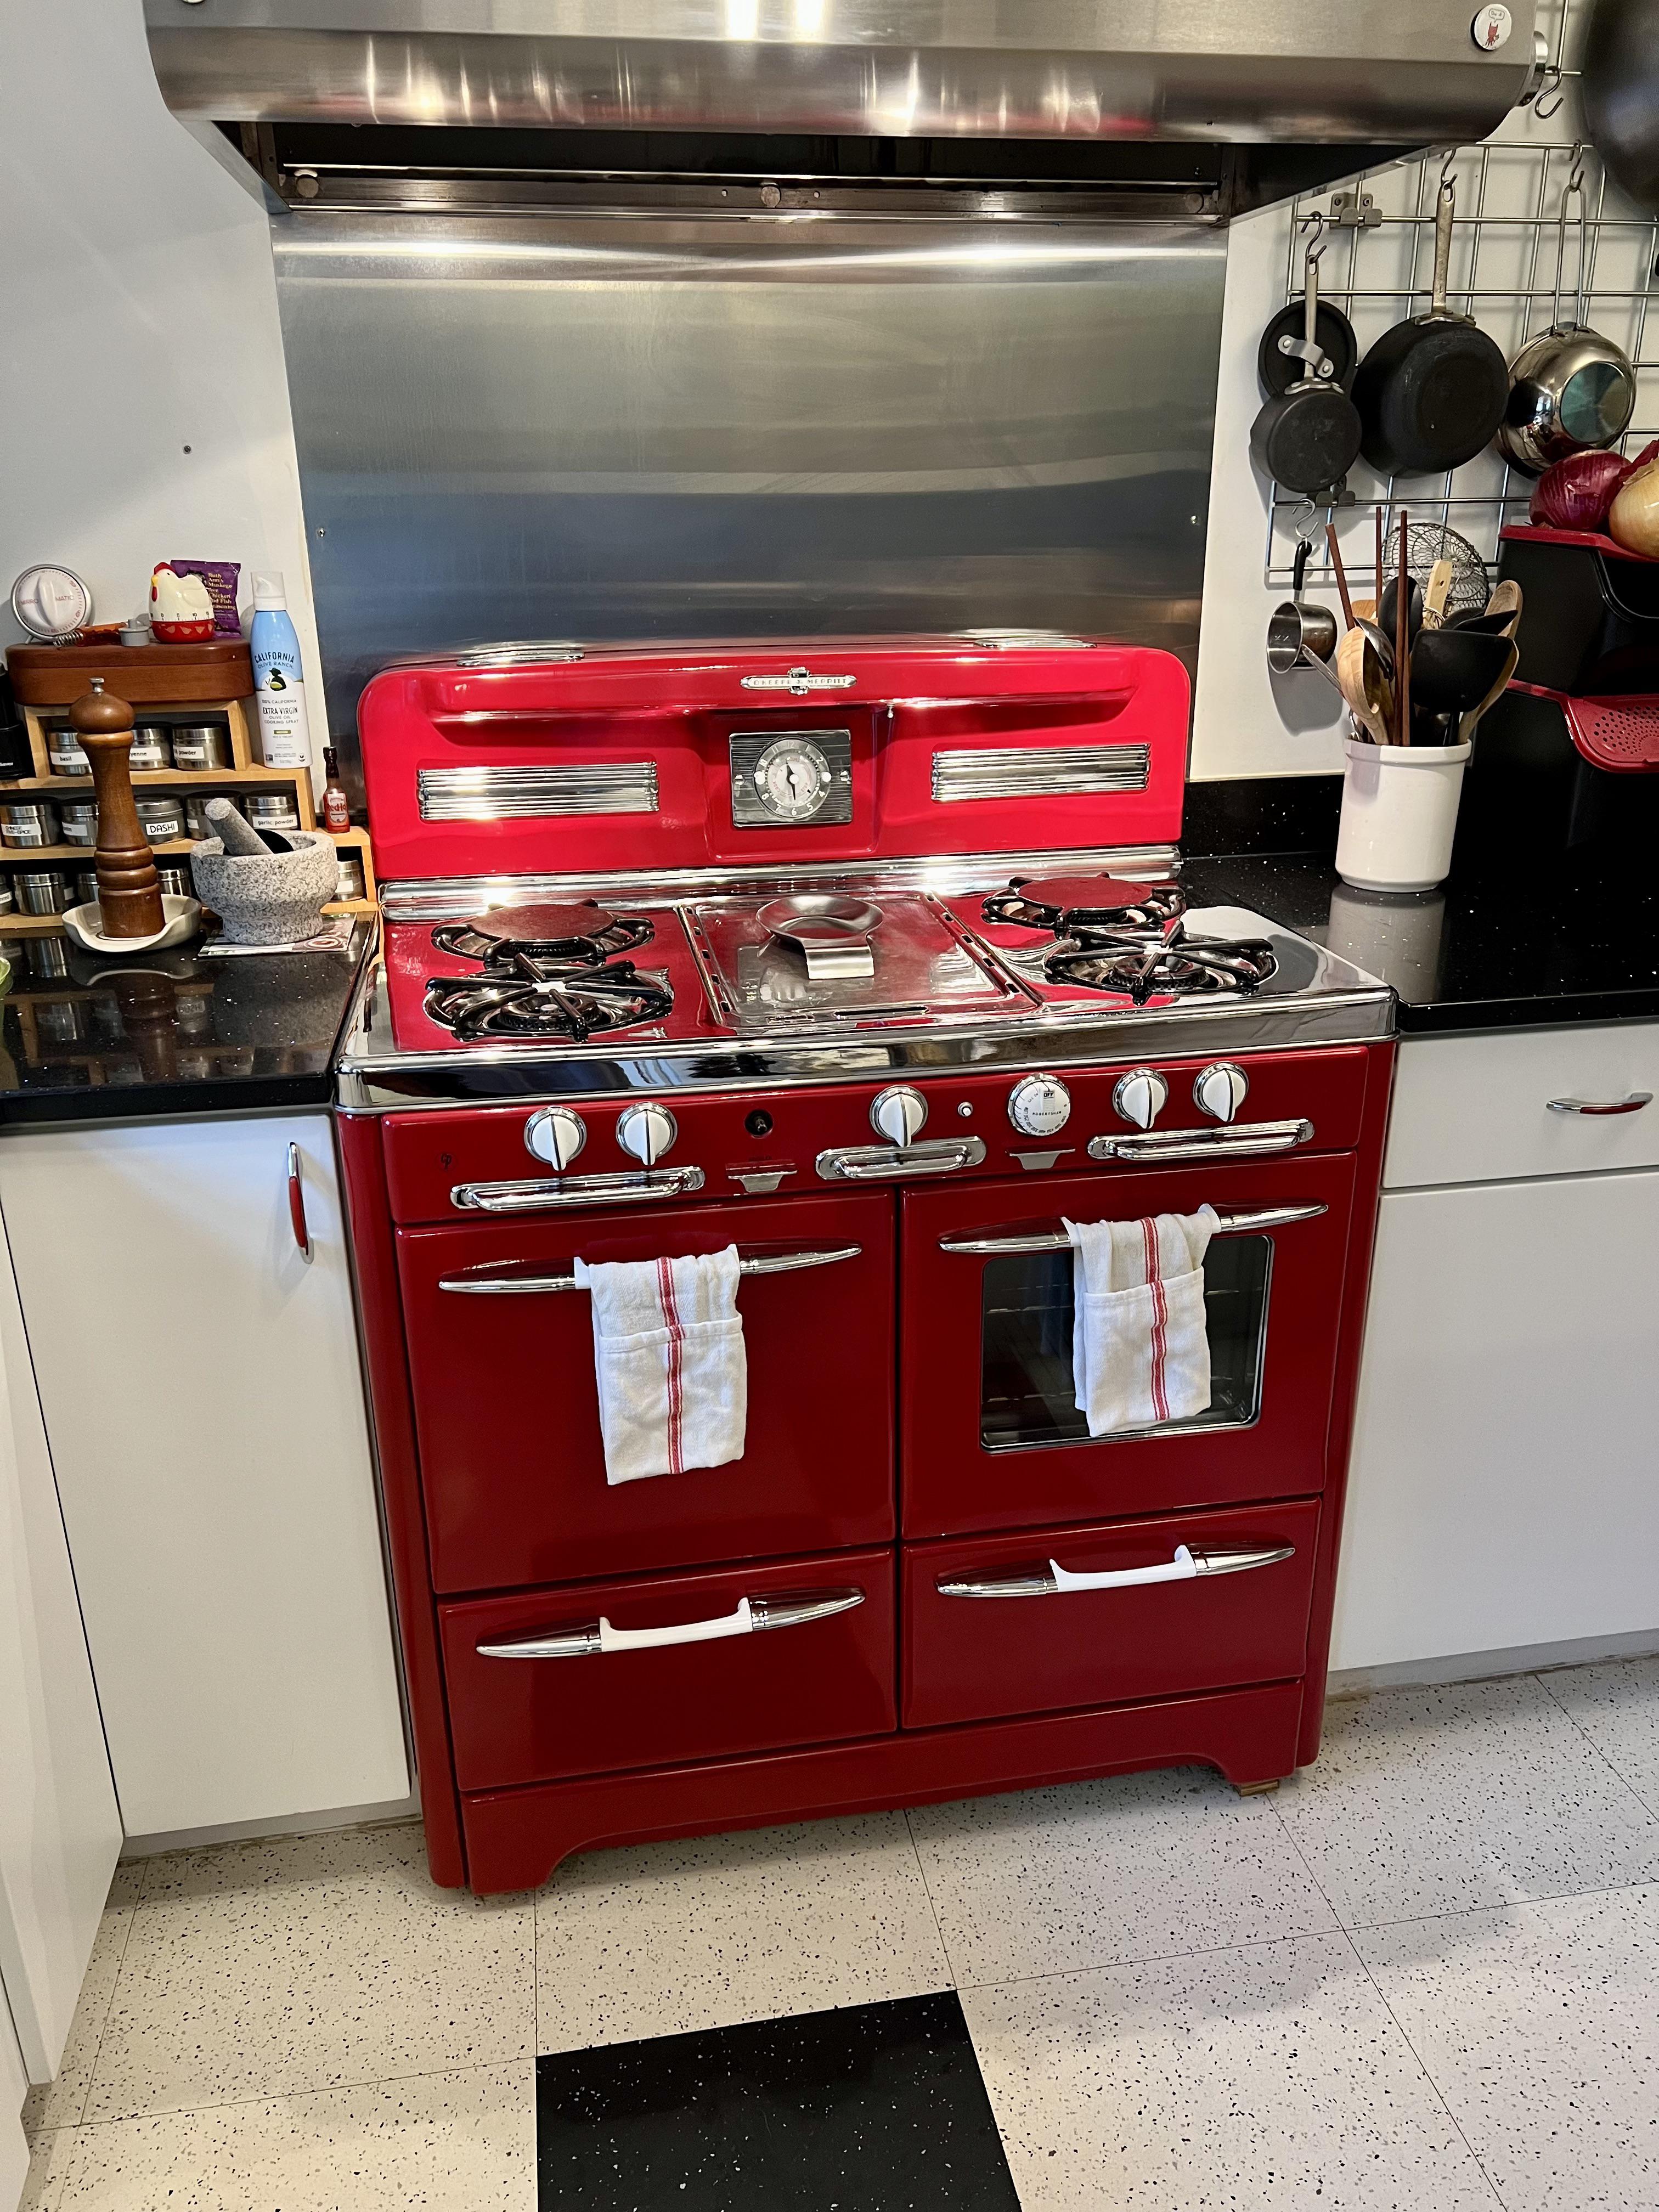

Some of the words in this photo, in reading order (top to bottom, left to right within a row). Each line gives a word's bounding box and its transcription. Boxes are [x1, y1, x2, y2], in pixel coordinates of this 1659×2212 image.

[254, 652, 295, 664] CALIFORNIA
[815, 756, 824, 764] 2
[775, 803, 782, 812] 7
[806, 802, 814, 811] 5
[791, 808, 797, 816] 6
[150, 824, 175, 833] DASHI
